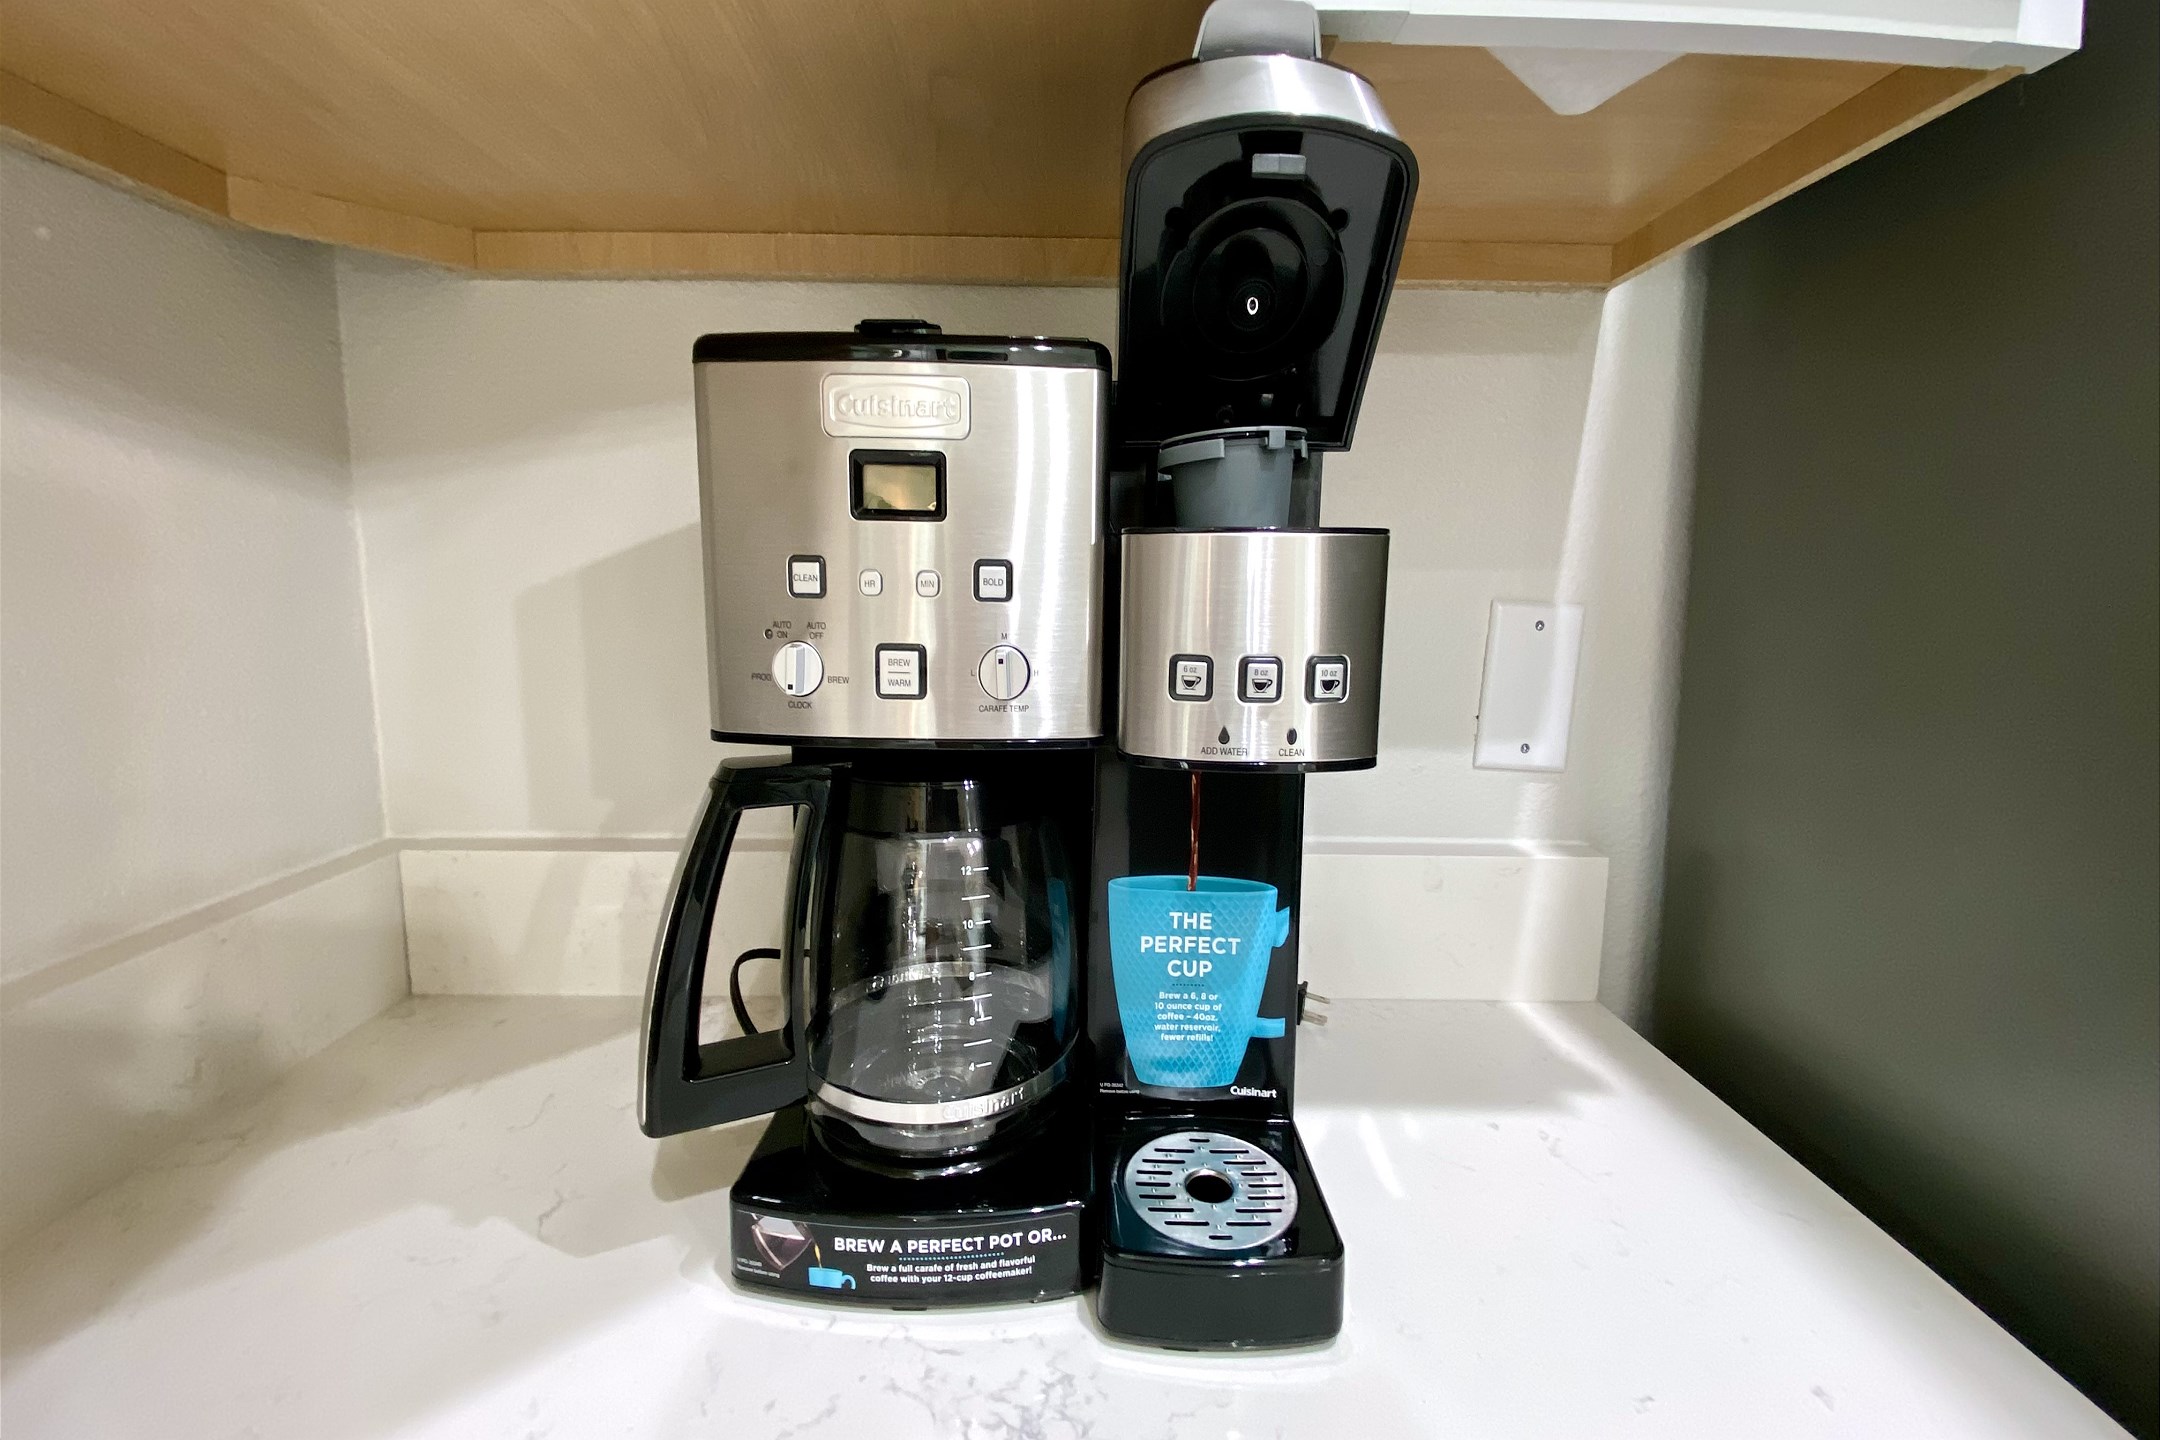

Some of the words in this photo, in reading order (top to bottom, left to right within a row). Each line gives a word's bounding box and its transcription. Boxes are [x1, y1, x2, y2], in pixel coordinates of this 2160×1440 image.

[837, 393, 956, 419] Cuisinart
[793, 574, 818, 583] CLEAN
[983, 578, 1004, 587] BOLD
[864, 580, 876, 588] HR
[920, 580, 935, 588] MIN
[773, 621, 792, 629] AUTO
[806, 622, 826, 630] AUTO
[888, 659, 911, 667] BREW
[751, 673, 772, 681] PROG
[1321, 669, 1328, 677] 10
[828, 676, 850, 684] BREW
[888, 679, 911, 687] WARM
[788, 701, 812, 709] CLOCK
[978, 705, 1008, 713] CARAFE
[1201, 747, 1218, 755] ADD
[1220, 747, 1248, 757] WATER
[1278, 748, 1305, 757] CLEAN
[961, 866, 972, 876] 12
[962, 920, 974, 929] 10
[1169, 912, 1212, 930] THE
[1140, 936, 1241, 955] PERFECT
[1167, 960, 1212, 978] CUP
[968, 972, 975, 980] 8
[1159, 992, 1181, 1000] Brew
[1190, 992, 1198, 1000] 6,
[1194, 1003, 1210, 1011] cup
[1212, 1003, 1222, 1011] of
[1157, 1012, 1184, 1020] coffee
[1193, 1013, 1218, 1021] 40oz.
[969, 1017, 975, 1026] 6
[1186, 1034, 1214, 1042] refills!
[968, 1062, 975, 1071] 4
[1230, 1086, 1277, 1098] Cuisinart
[834, 1237, 885, 1253] BREW
[889, 1240, 902, 1254] A
[907, 1236, 984, 1254] PERFECT
[989, 1232, 1023, 1249] POT
[1028, 1228, 1067, 1244] OR...
[866, 1264, 888, 1272] Brew
[898, 1264, 913, 1272] full
[914, 1264, 943, 1272] carafe
[944, 1263, 954, 1272] of
[956, 1262, 979, 1272] fresh
[980, 1260, 997, 1270] and
[999, 1254, 1036, 1268] flavorful
[870, 1274, 898, 1282] coffee
[900, 1274, 919, 1282] with
[922, 1275, 941, 1284] your
[944, 1274, 973, 1284] 12-cup
[975, 1266, 1032, 1281] coffeemaker!
